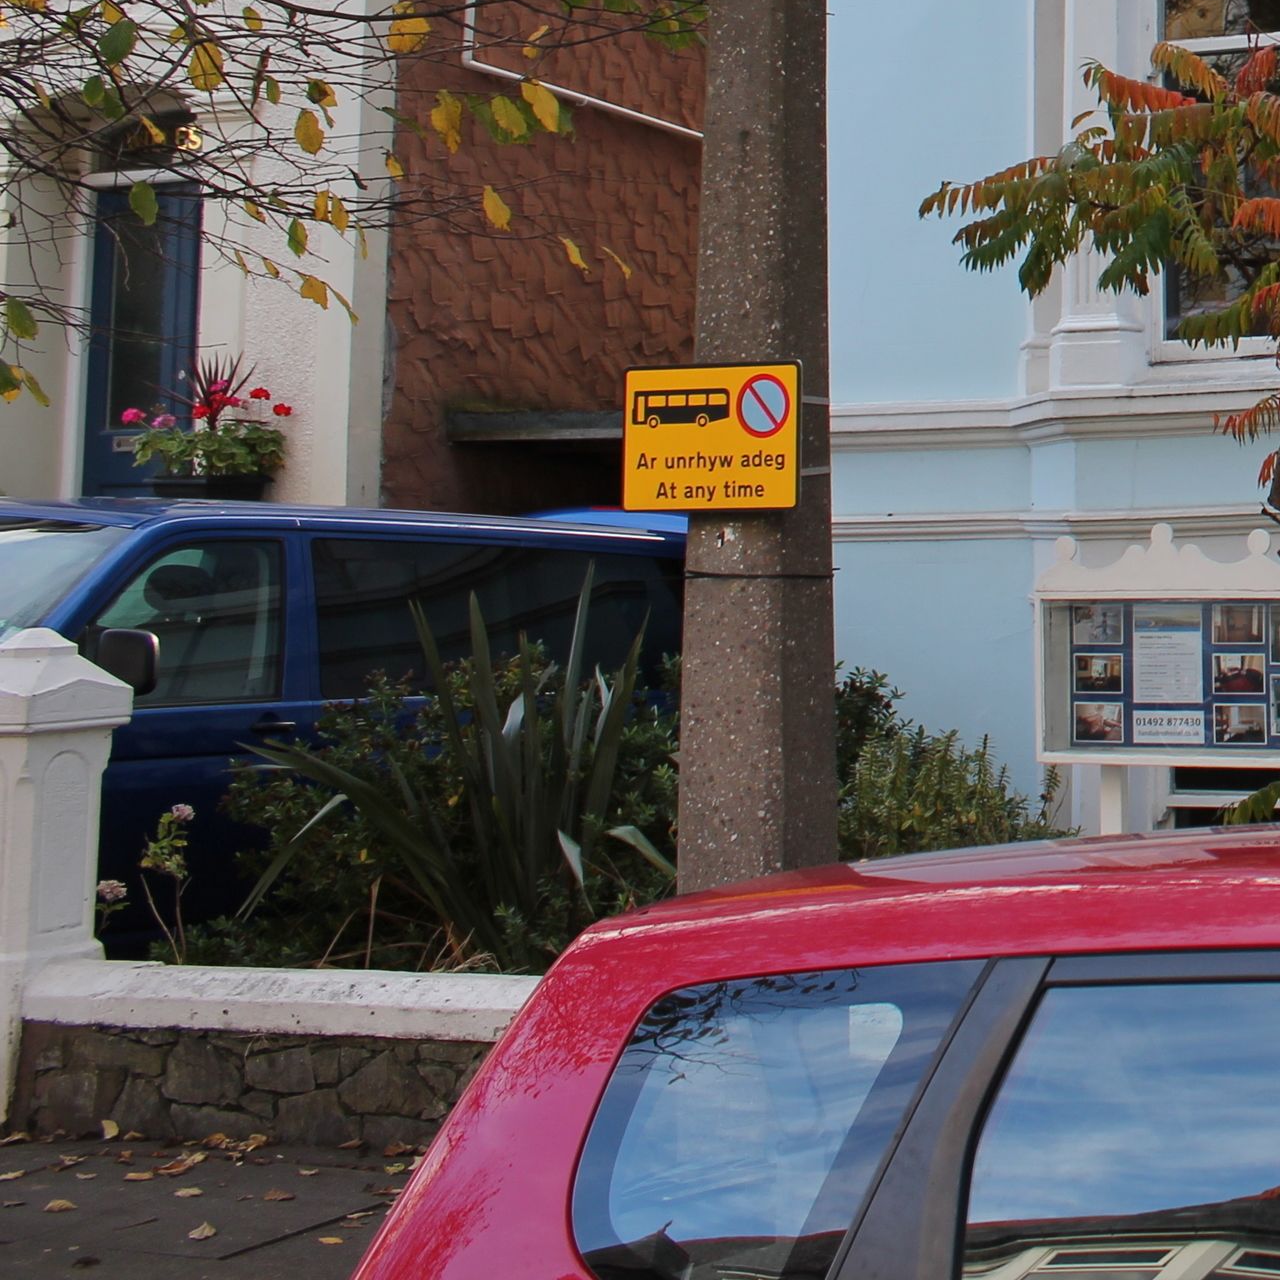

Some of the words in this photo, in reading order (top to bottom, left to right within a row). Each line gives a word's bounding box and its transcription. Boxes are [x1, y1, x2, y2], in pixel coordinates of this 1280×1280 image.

[636, 452, 657, 470] Ar
[665, 452, 733, 472] unrhyw
[741, 450, 785, 470] adeg
[656, 482, 677, 499] At
[684, 485, 716, 502] any
[724, 481, 765, 498] time
[1135, 717, 1164, 726] 01492
[1167, 717, 1201, 726] 877430
